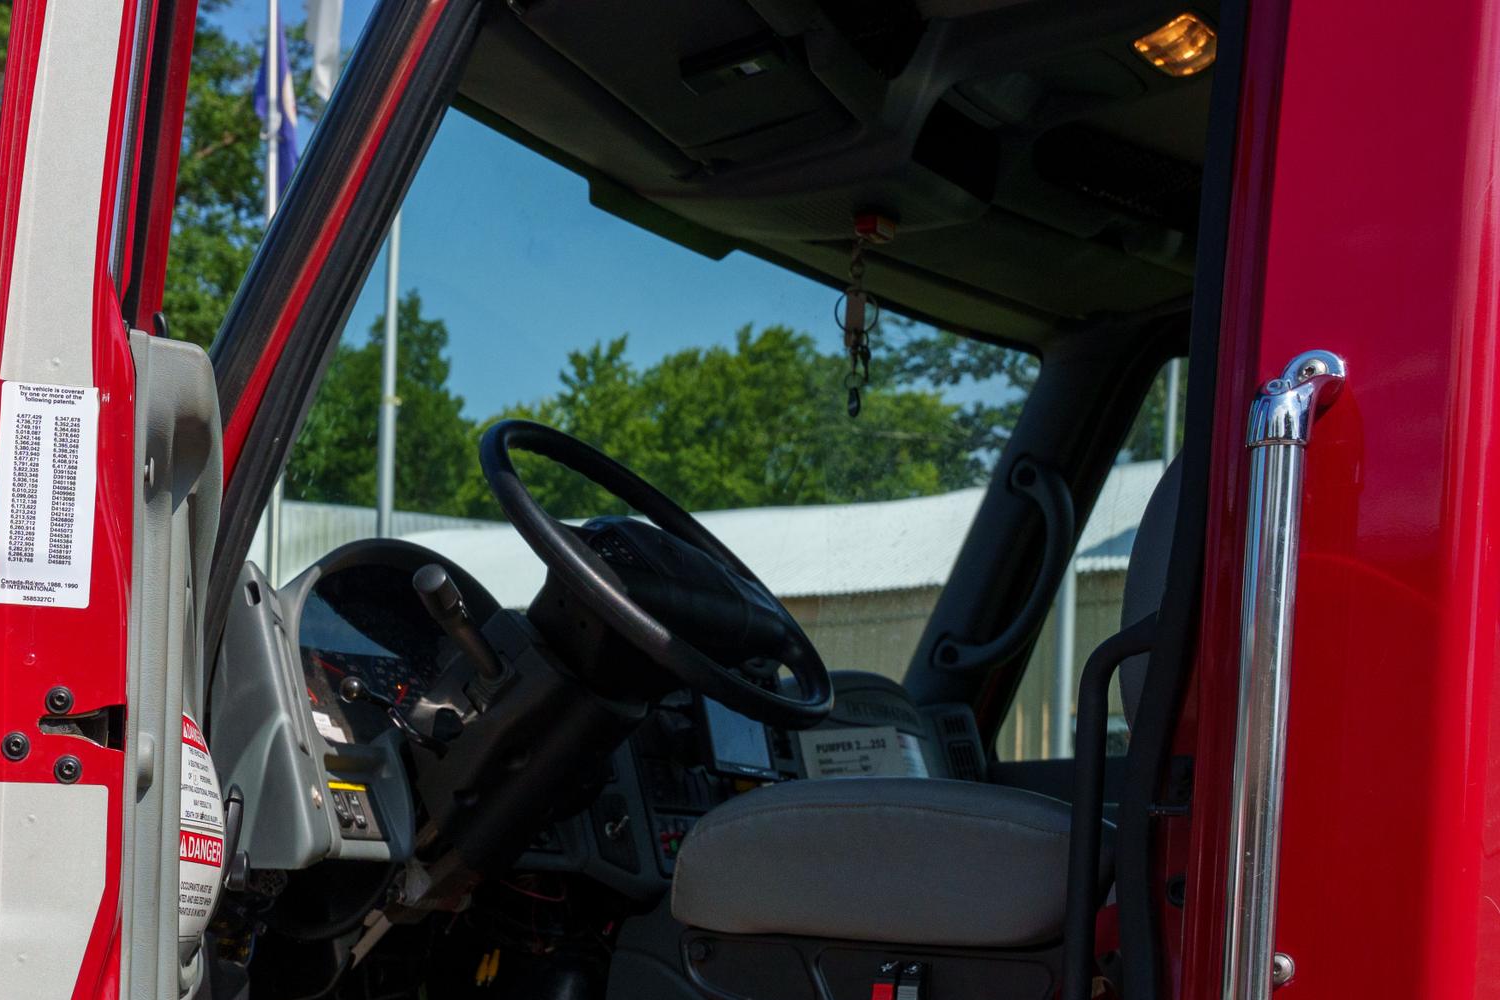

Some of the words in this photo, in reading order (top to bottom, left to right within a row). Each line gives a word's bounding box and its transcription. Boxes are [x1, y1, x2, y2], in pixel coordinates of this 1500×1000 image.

[7, 584, 56, 592] INTERNATIONAL
[816, 742, 852, 753] PUMPER
[188, 836, 221, 864] DANGER
